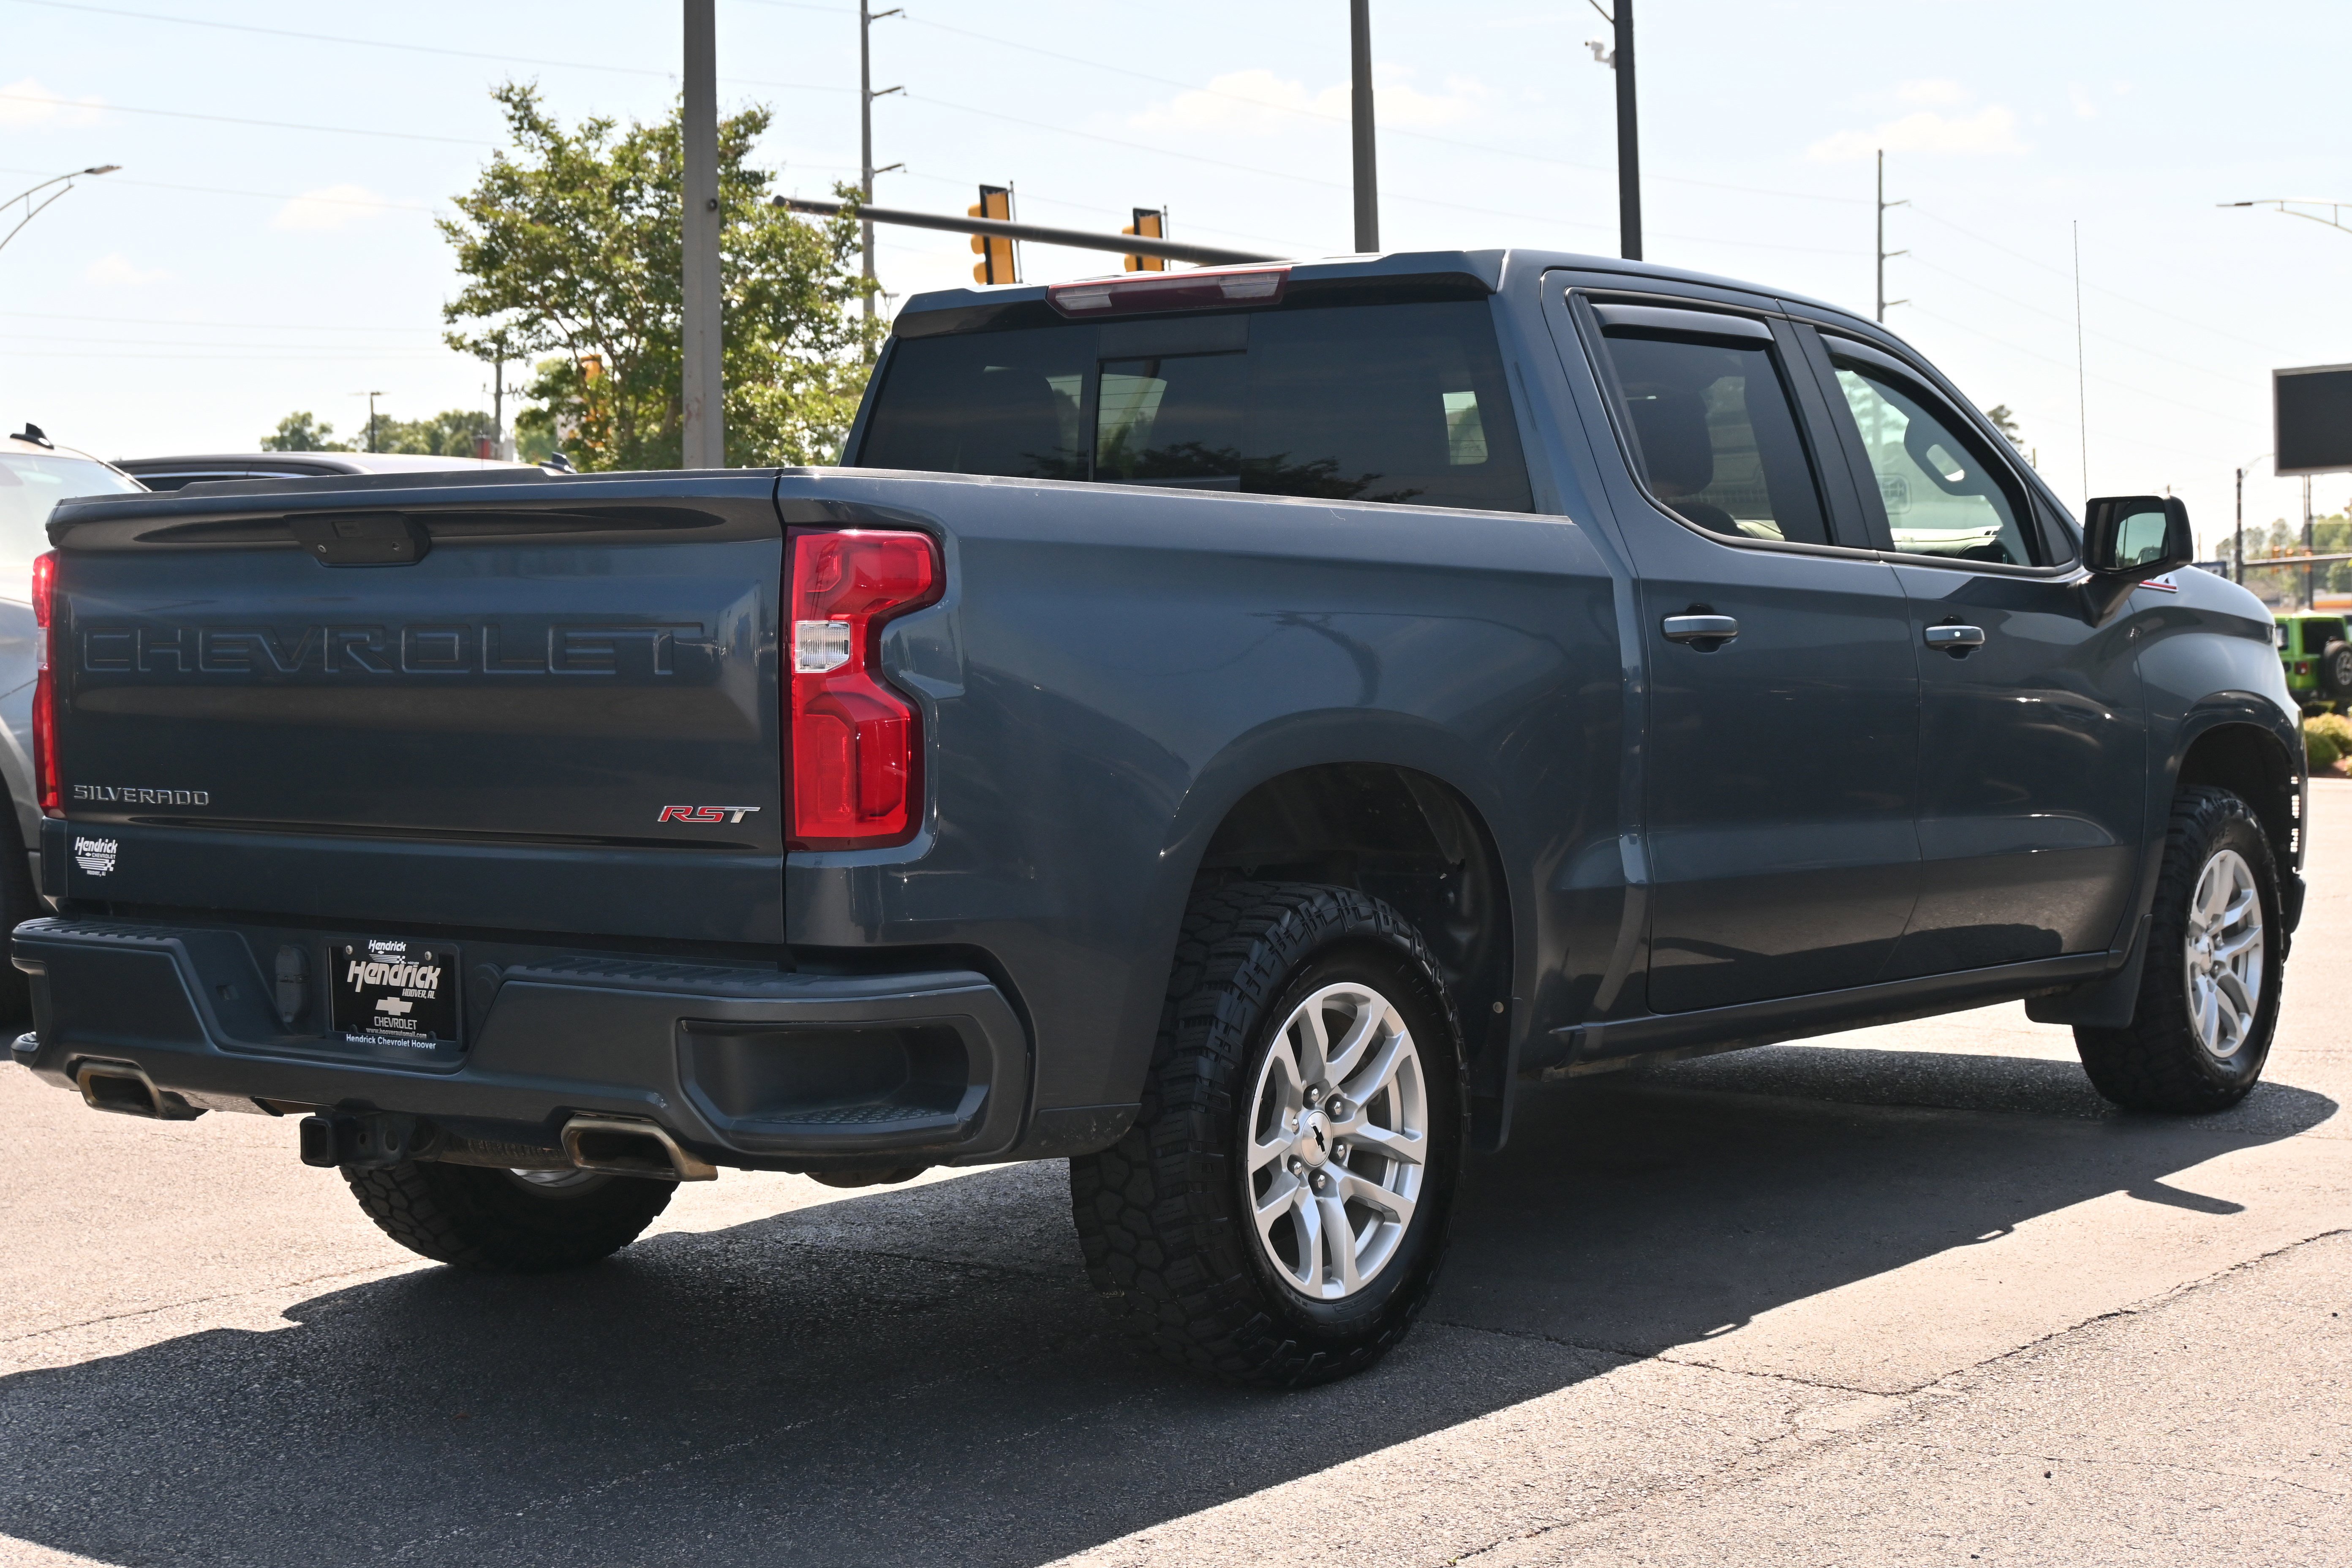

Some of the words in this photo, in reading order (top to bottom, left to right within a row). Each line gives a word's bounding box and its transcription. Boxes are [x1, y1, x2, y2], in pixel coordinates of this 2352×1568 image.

[84, 622, 705, 675] CHEVROLET
[74, 784, 209, 806] SILVERADO
[657, 806, 761, 823] RST
[74, 836, 118, 855] Hendrick
[368, 939, 406, 953] Hendrick
[347, 960, 441, 993] Hendrick
[402, 988, 427, 999] HOOVER,
[427, 990, 436, 999] AL
[374, 1016, 417, 1030] CHEVROLET
[346, 1033, 376, 1044] Hendrick
[377, 1036, 410, 1047] Chevrolet
[411, 1039, 436, 1050] Hoover
[366, 1027, 427, 1039] www.hooverautomall.com
